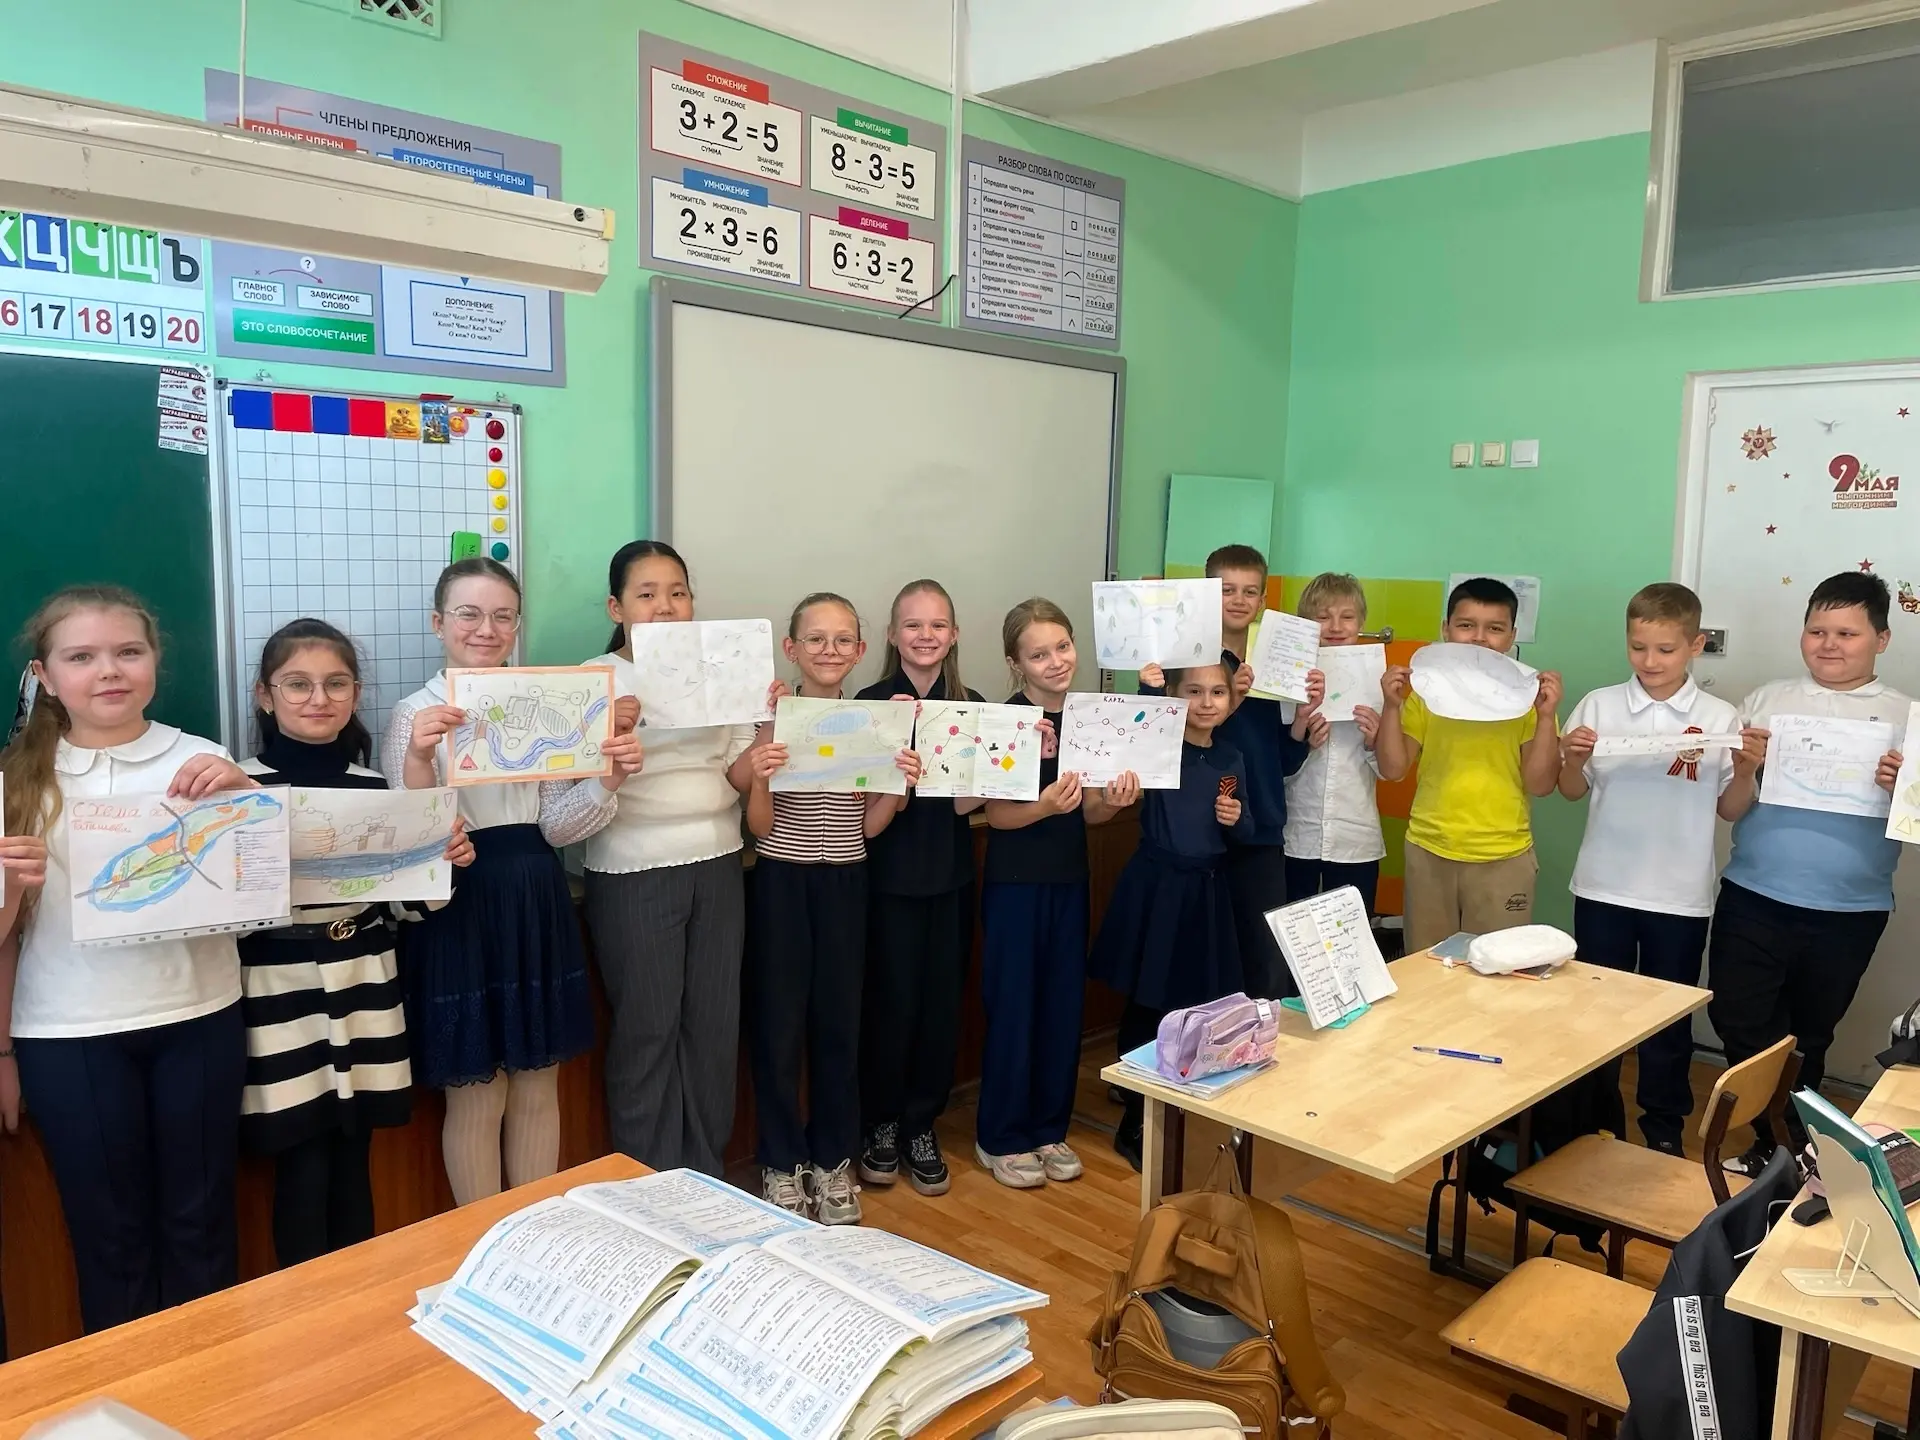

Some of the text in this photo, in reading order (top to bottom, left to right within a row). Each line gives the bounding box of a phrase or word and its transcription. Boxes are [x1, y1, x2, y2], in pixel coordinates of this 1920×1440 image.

[706, 74, 747, 92] СЛОЖЕНИЕ
[671, 83, 746, 110] СЛАГАЕМОЕ СЛАГАЕМОЕ
[320, 111, 471, 152] ЧЛЕНЫ ПРЕДЛОЖЕНИЯ
[855, 119, 891, 136] ВЫЧИТАНИЕ
[821, 127, 891, 152] УМЕНЬШАЕМОЕ ВЫЧИТАЕМОЕ
[701, 146, 721, 156] СУММА
[404, 154, 491, 180] ВТОРОСТЕПЕННЫЕ
[494, 173, 525, 186] ЧЛЕНЫ
[758, 156, 784, 168] ЗНАЧЕНИЕ
[761, 166, 780, 176] СУММЫ
[999, 156, 1096, 189] РАЗБОР СЛОВА ПО СОСТАВУ
[704, 179, 749, 197] УМНОЖЕНИЕ
[846, 184, 869, 194] РАЗНОСТЬ
[670, 192, 747, 215] МНОЖИТЕЛЬ МНОЖИТЕЛЬ
[896, 193, 919, 203] ЗНАЧЕНИЕ
[896, 201, 919, 211] РАЗНОСТИ
[861, 218, 888, 230] ДЕЛЕНИЕ
[27, 219, 66, 272] Ц
[829, 229, 886, 247] ДЕЛИМОЕ ДЕЛИТЕЛЬ
[76, 226, 108, 272] Ч
[119, 232, 159, 283] Щ
[687, 249, 731, 263] ПРОИЗВЕДЕНИЕ
[163, 239, 199, 282] Ъ
[757, 259, 783, 270] ЗНАЧЕНИЕ
[750, 267, 790, 279] ПРОИЗВЕДЕНИЯ
[239, 282, 277, 293] ГЛАВНОЕ
[848, 282, 869, 290] ЧАСТНОЕ
[896, 287, 918, 296] ЗНАЧЕНИЕ
[244, 291, 273, 301] СЛОВО
[311, 290, 359, 303] ЗАВИСИМОЕ
[445, 298, 494, 310] ДОПОЛНЕНИЕ
[0, 300, 18, 326] 6
[322, 301, 350, 310] СЛОВО
[31, 303, 65, 330] 17
[78, 308, 112, 335] 18
[123, 312, 156, 339] 19
[167, 317, 200, 344] 20
[242, 321, 367, 342] ЭТО СЛОВОСОЧЕТАНИЕ
[1828, 455, 1899, 492] 9 МАЯ
[73, 802, 142, 819] Схема
[1686, 1296, 1701, 1352] this is my era
[1693, 1364, 1706, 1378] this
[1695, 1390, 1708, 1403] my
[1700, 1405, 1710, 1417] era
